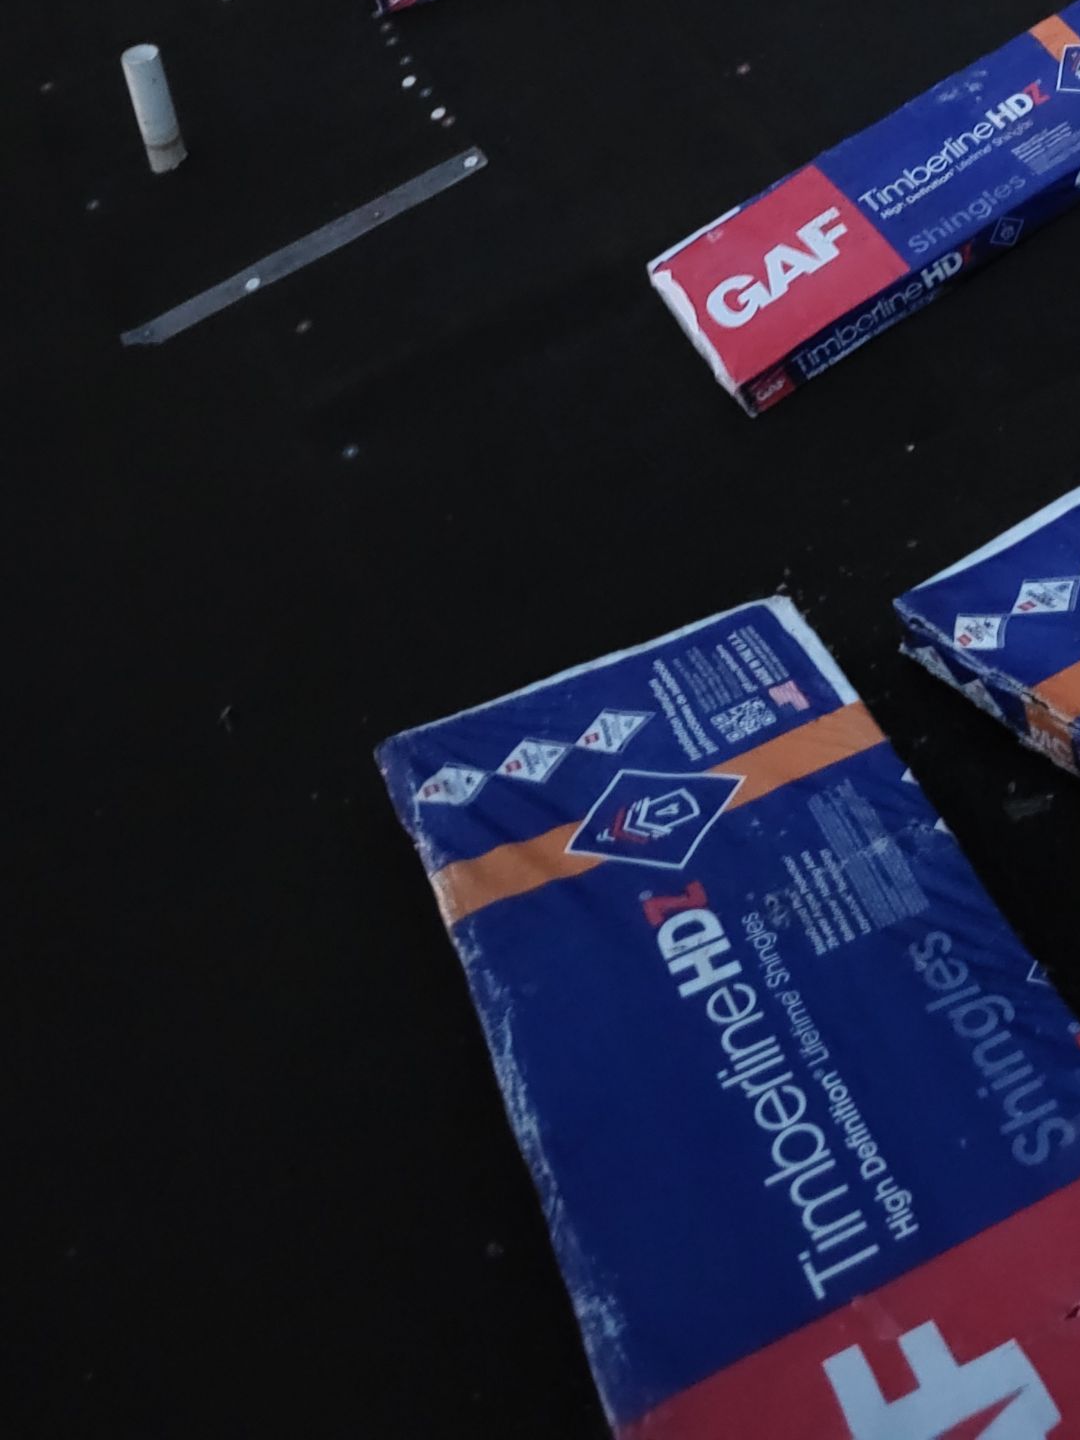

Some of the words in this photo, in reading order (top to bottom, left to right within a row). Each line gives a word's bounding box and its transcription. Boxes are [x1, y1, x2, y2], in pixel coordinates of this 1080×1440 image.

[857, 80, 1052, 212] TimberlineHDZ
[706, 206, 848, 329] GAF
[908, 174, 1028, 254] Shingles
[741, 911, 791, 991] Shingles
[779, 989, 830, 1068] Lifetime
[908, 929, 1076, 1166] Shingles
[641, 880, 881, 1301] TimberlineHDZ
[822, 1070, 889, 1181] Definition
[874, 1176, 920, 1241] High
